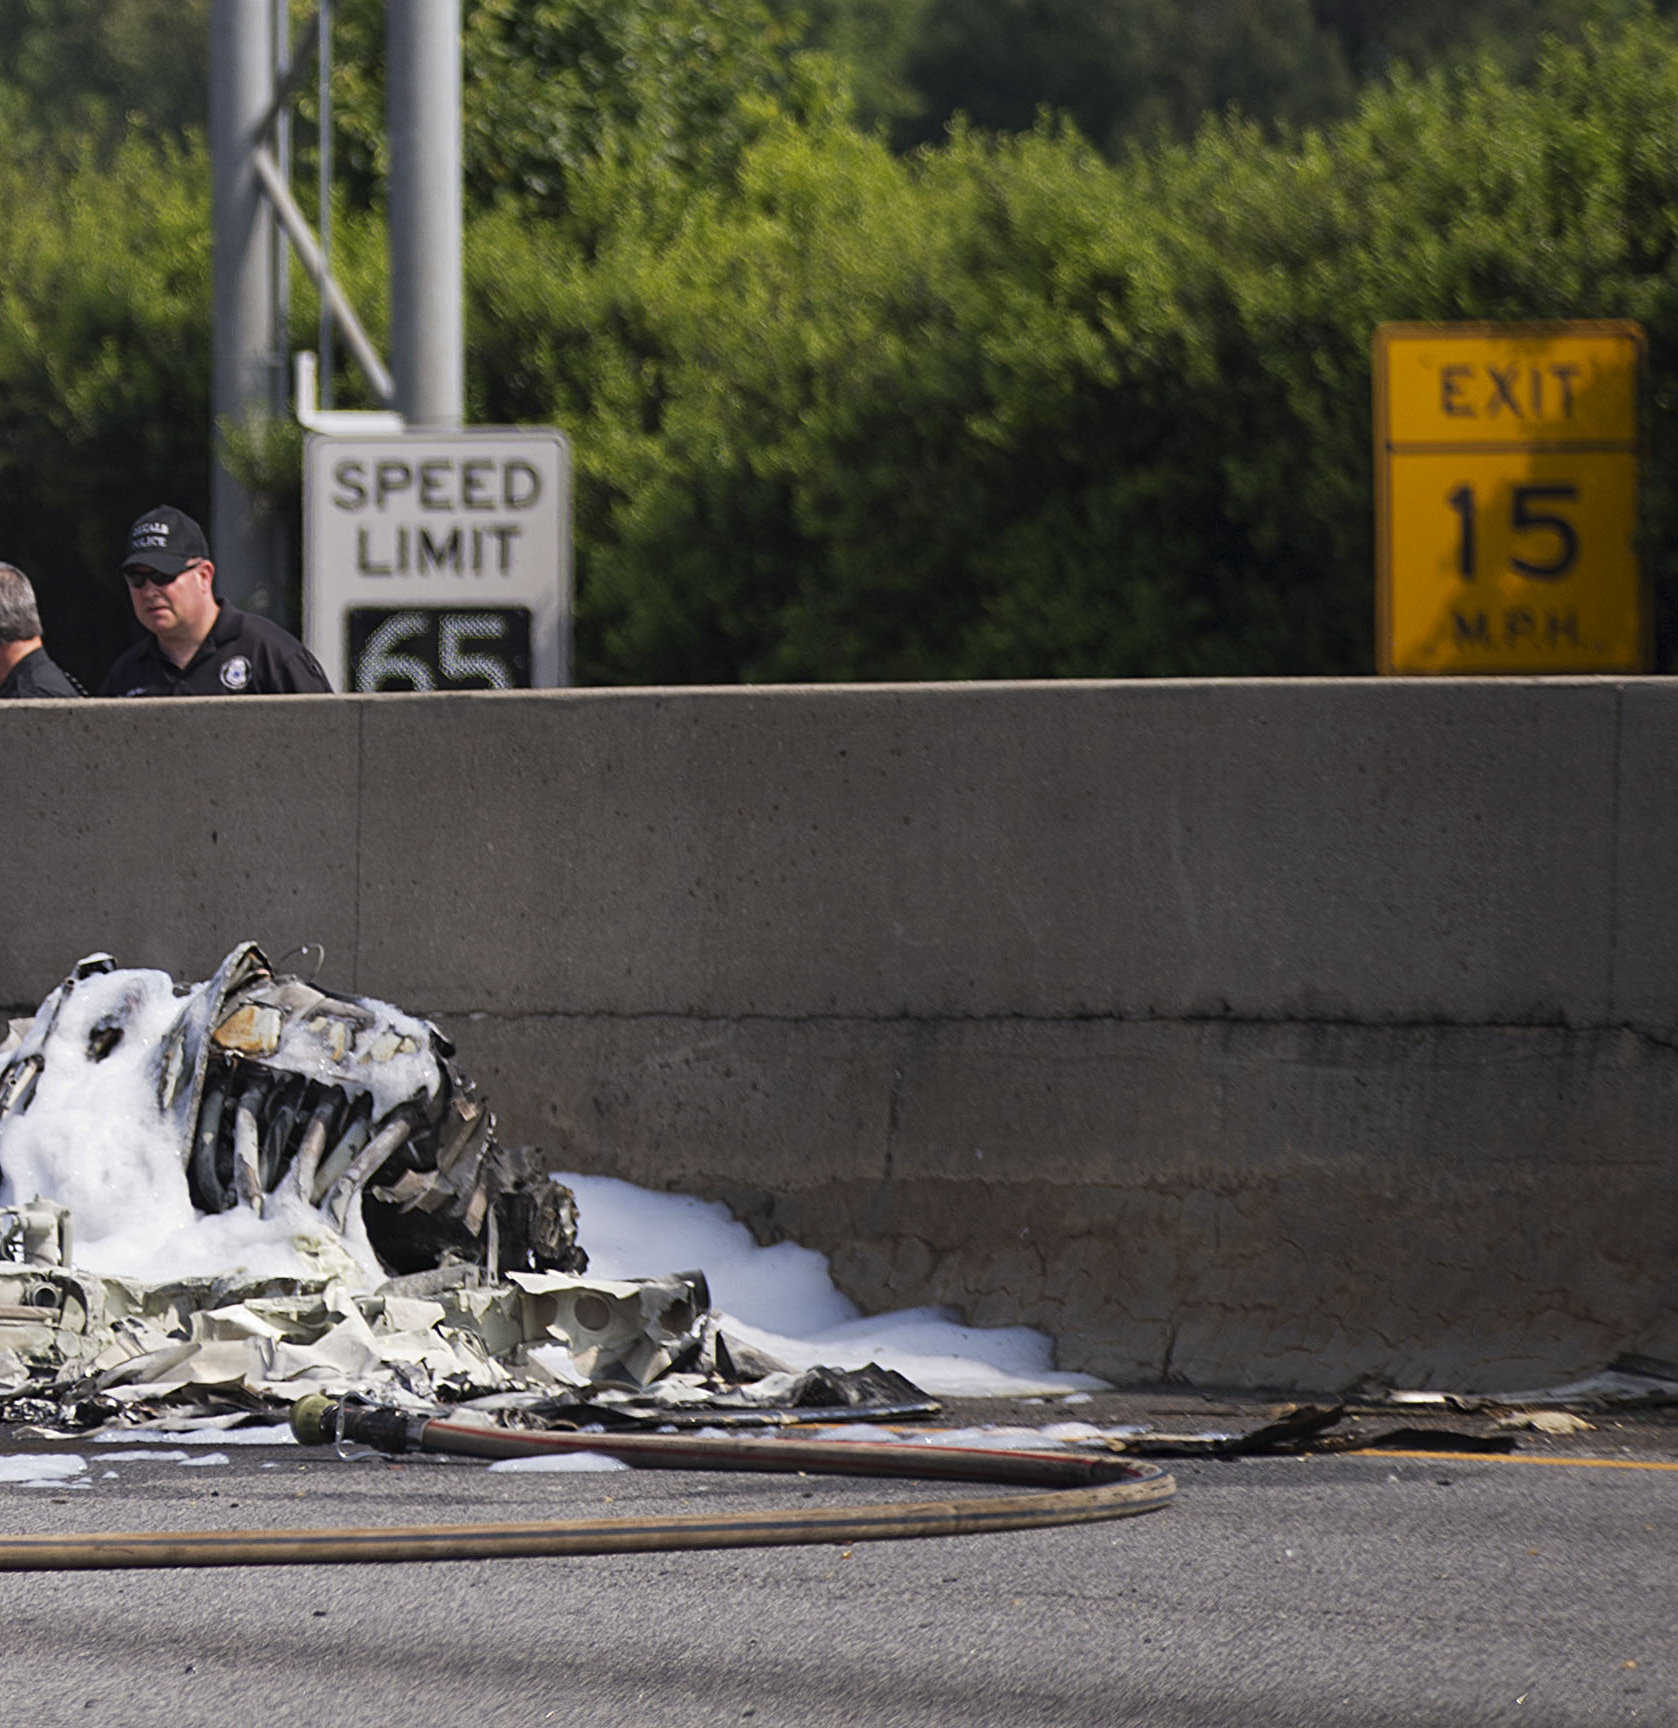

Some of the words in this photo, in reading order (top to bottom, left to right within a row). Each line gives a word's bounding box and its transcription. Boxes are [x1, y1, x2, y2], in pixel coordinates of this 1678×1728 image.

[1440, 363, 1582, 419] EXIT
[331, 458, 543, 512] SPEED
[356, 524, 522, 578] LIMIT
[1448, 482, 1581, 582] 15
[355, 612, 513, 691] 65
